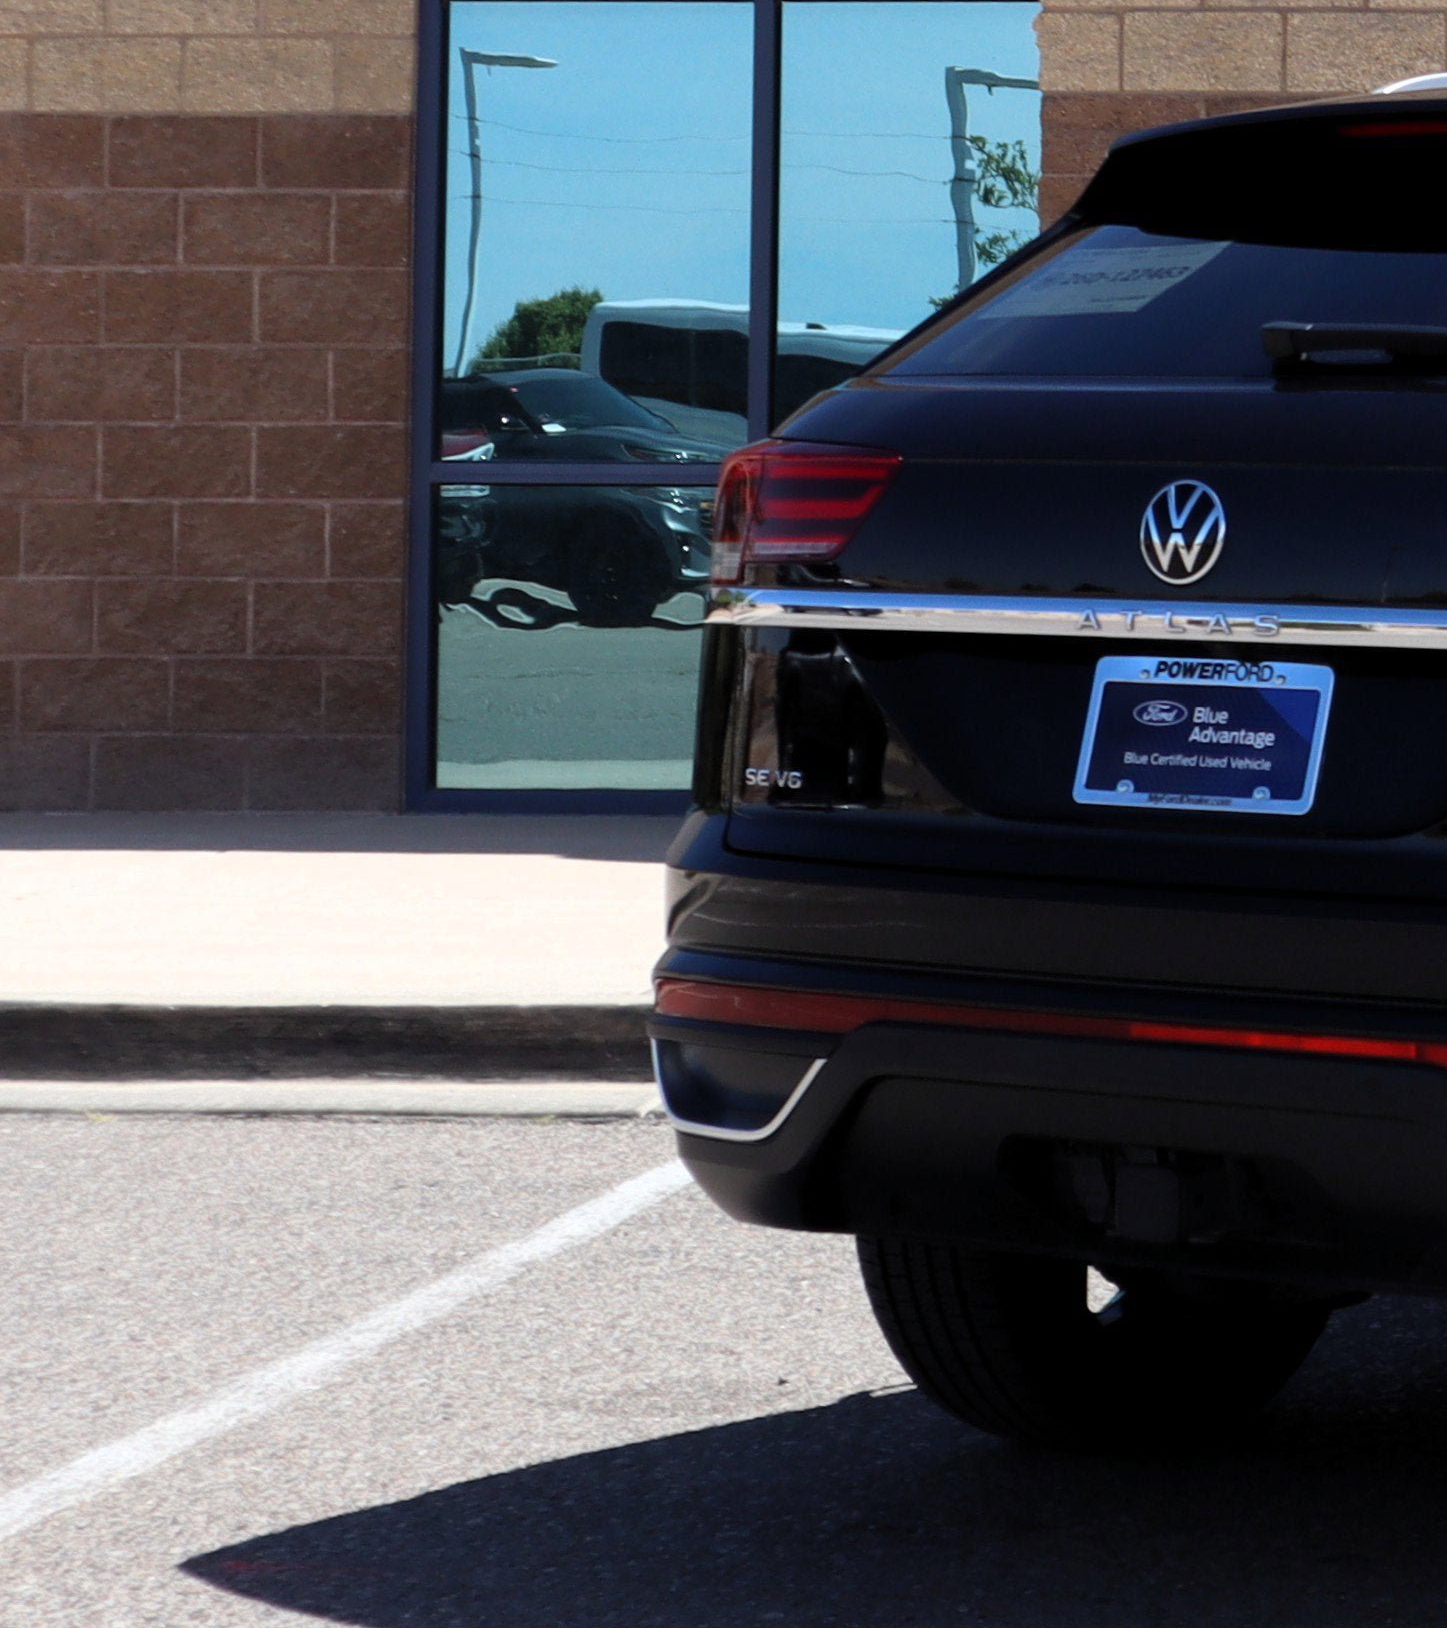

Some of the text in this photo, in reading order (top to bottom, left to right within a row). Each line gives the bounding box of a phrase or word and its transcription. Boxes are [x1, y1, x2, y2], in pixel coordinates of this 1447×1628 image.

[1077, 608, 1282, 637] ATLAS
[1154, 661, 1274, 682] POWERFORD
[1142, 704, 1228, 723] Ford Blue
[1189, 727, 1275, 748] Advantage
[1124, 752, 1271, 770] Blue Certified Used Vehicle
[746, 768, 801, 788] SE V6
